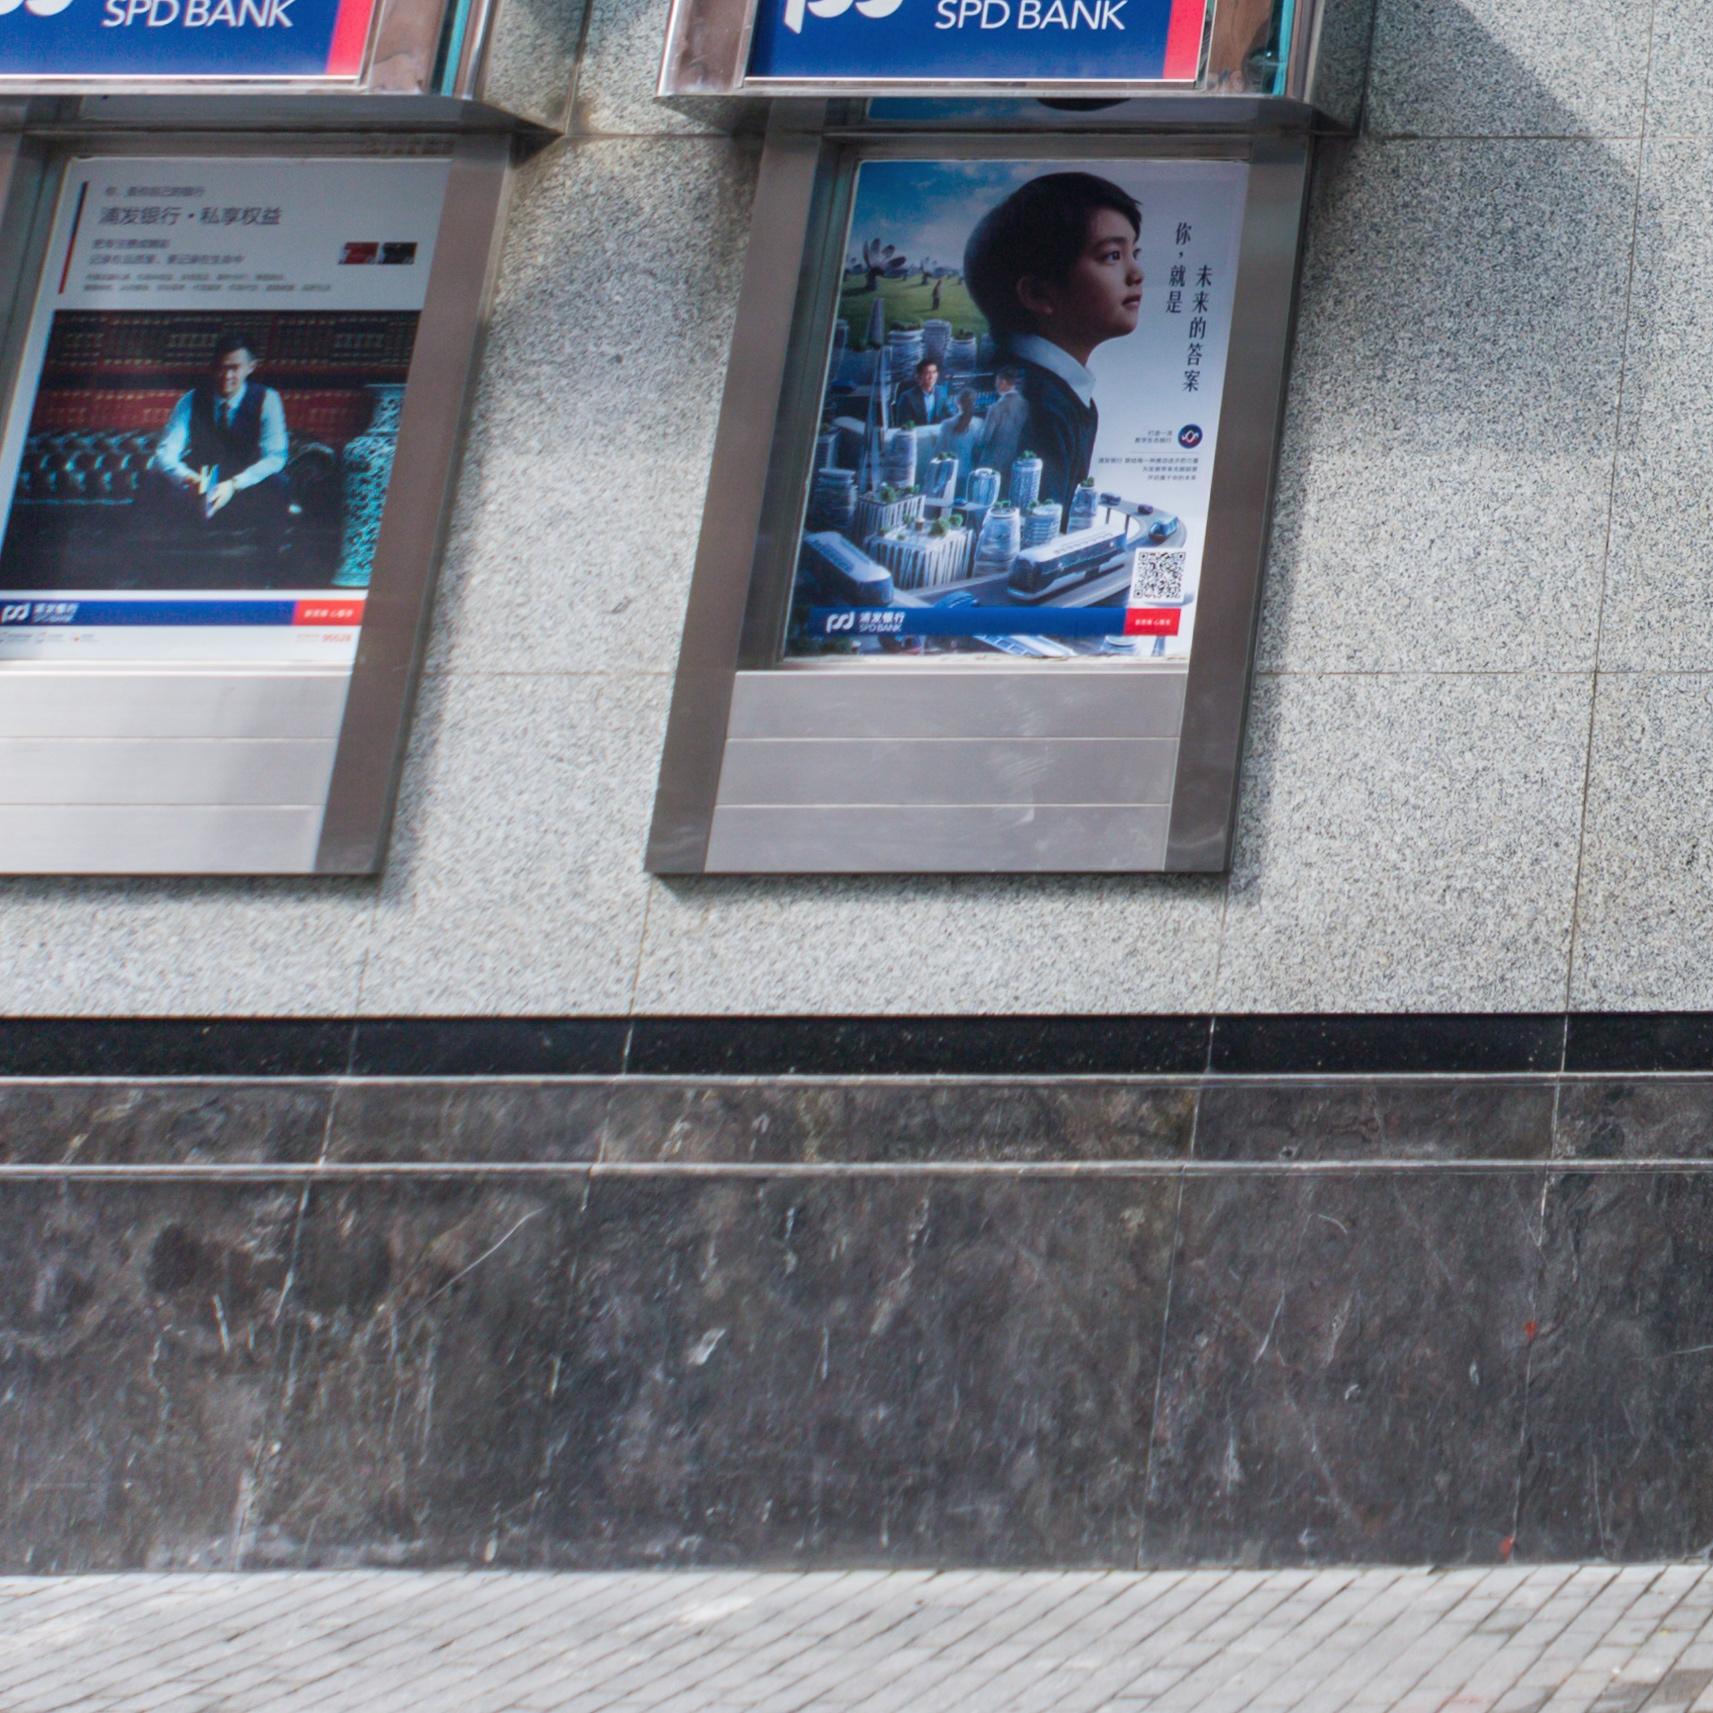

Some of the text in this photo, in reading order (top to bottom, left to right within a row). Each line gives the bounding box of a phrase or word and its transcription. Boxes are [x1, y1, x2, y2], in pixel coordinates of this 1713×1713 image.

[1181, 264, 1212, 392] 未来的答案
